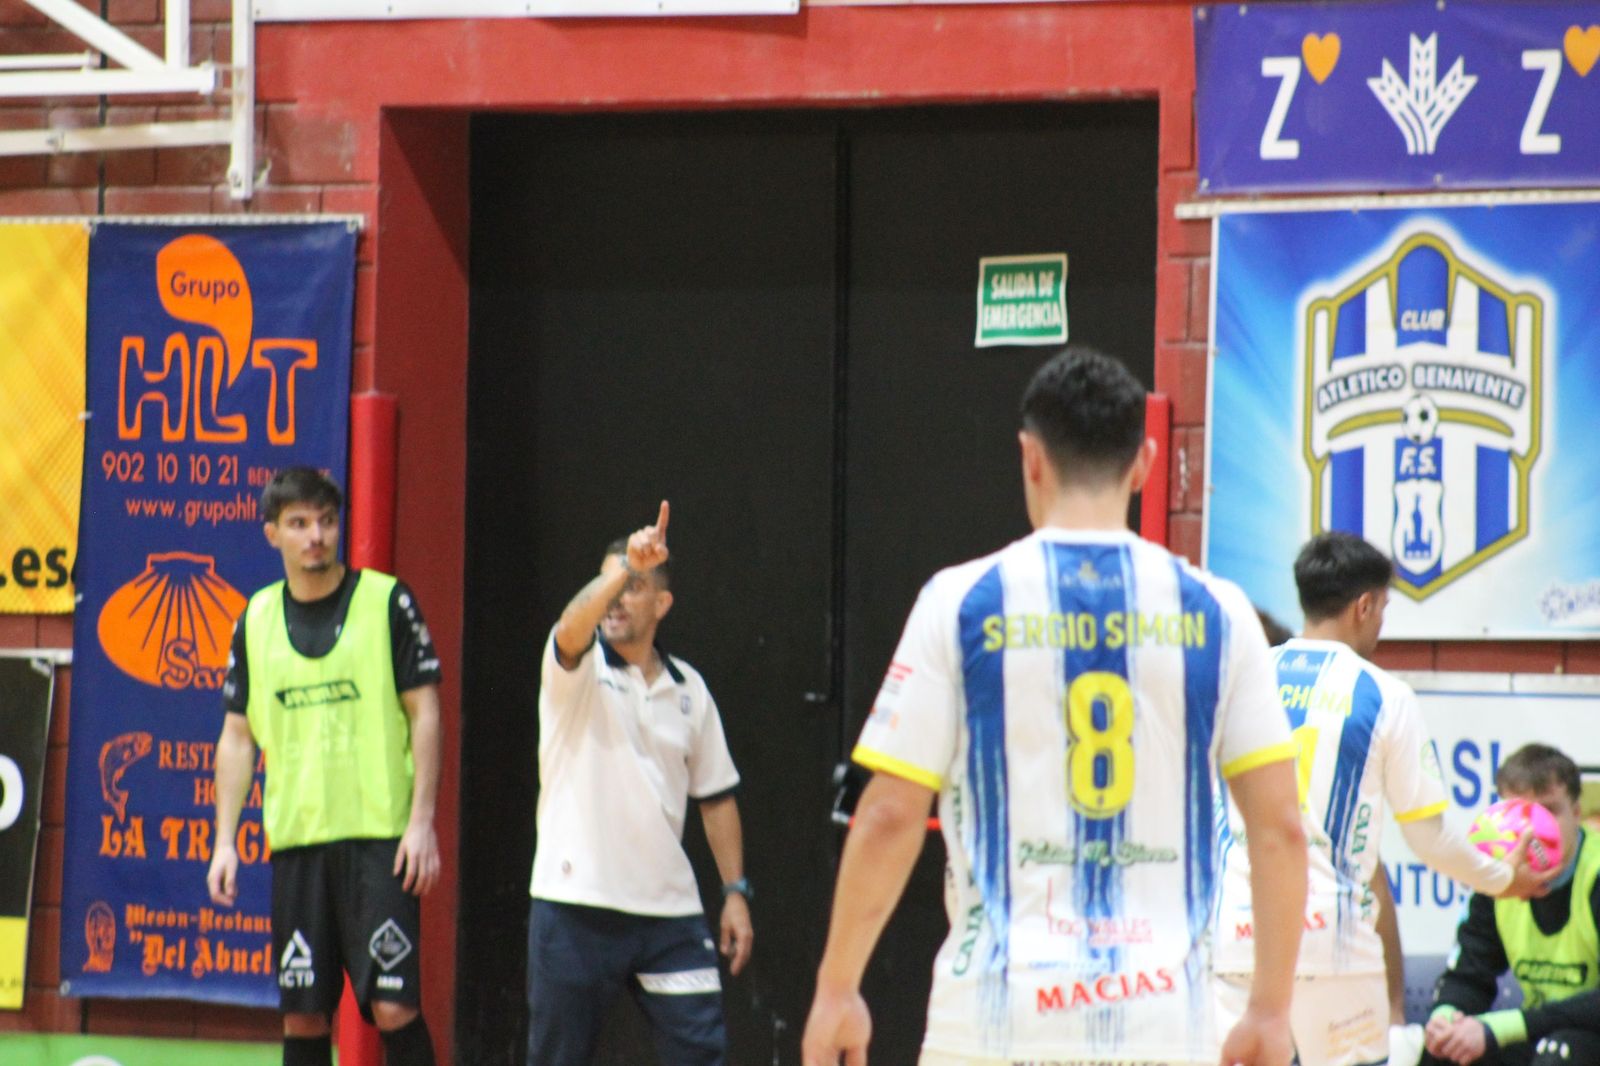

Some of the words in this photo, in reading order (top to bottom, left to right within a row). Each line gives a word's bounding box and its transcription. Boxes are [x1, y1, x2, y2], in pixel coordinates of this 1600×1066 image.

[170, 271, 241, 305] Grupo
[990, 271, 1037, 300] SALIDA
[1038, 270, 1055, 298] DE
[983, 301, 1062, 331] EMERGENCIA
[1400, 308, 1446, 332] CLUB
[117, 331, 319, 446] HLT
[1316, 363, 1407, 413] ATLETICO
[1411, 362, 1527, 411] BENAVENTE
[102, 452, 145, 484] 902
[157, 453, 179, 484] 10
[189, 454, 211, 485] 10
[217, 454, 239, 486] 21
[983, 612, 1096, 653] SERGIO
[1105, 610, 1206, 650] SIMON
[1065, 671, 1137, 820] 8
[99, 813, 147, 860] LA
[1035, 966, 1176, 1015] MACIAS
